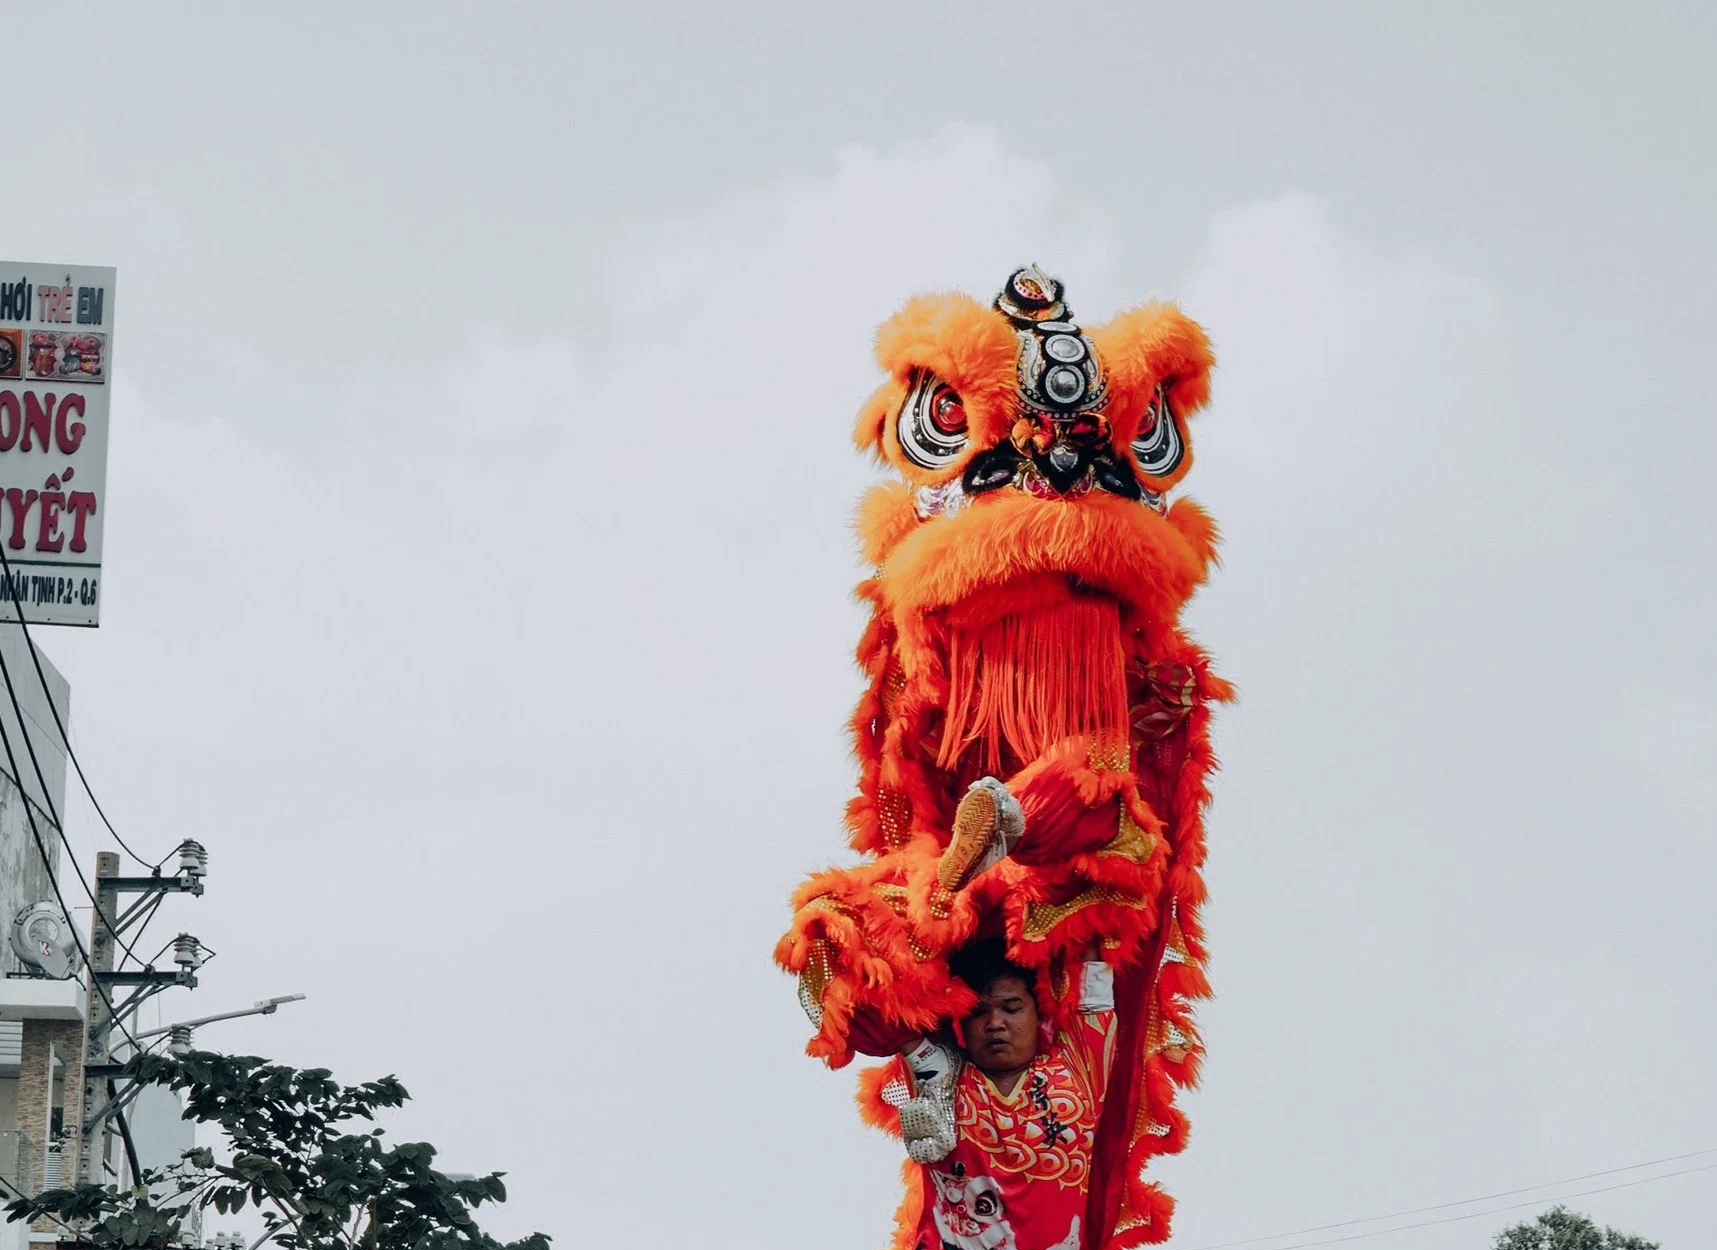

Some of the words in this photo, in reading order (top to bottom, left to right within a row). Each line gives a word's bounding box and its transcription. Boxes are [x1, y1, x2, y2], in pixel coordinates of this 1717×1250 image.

[77, 286, 104, 325] EM
[0, 389, 86, 454] ONG
[0, 466, 96, 553] YẾT
